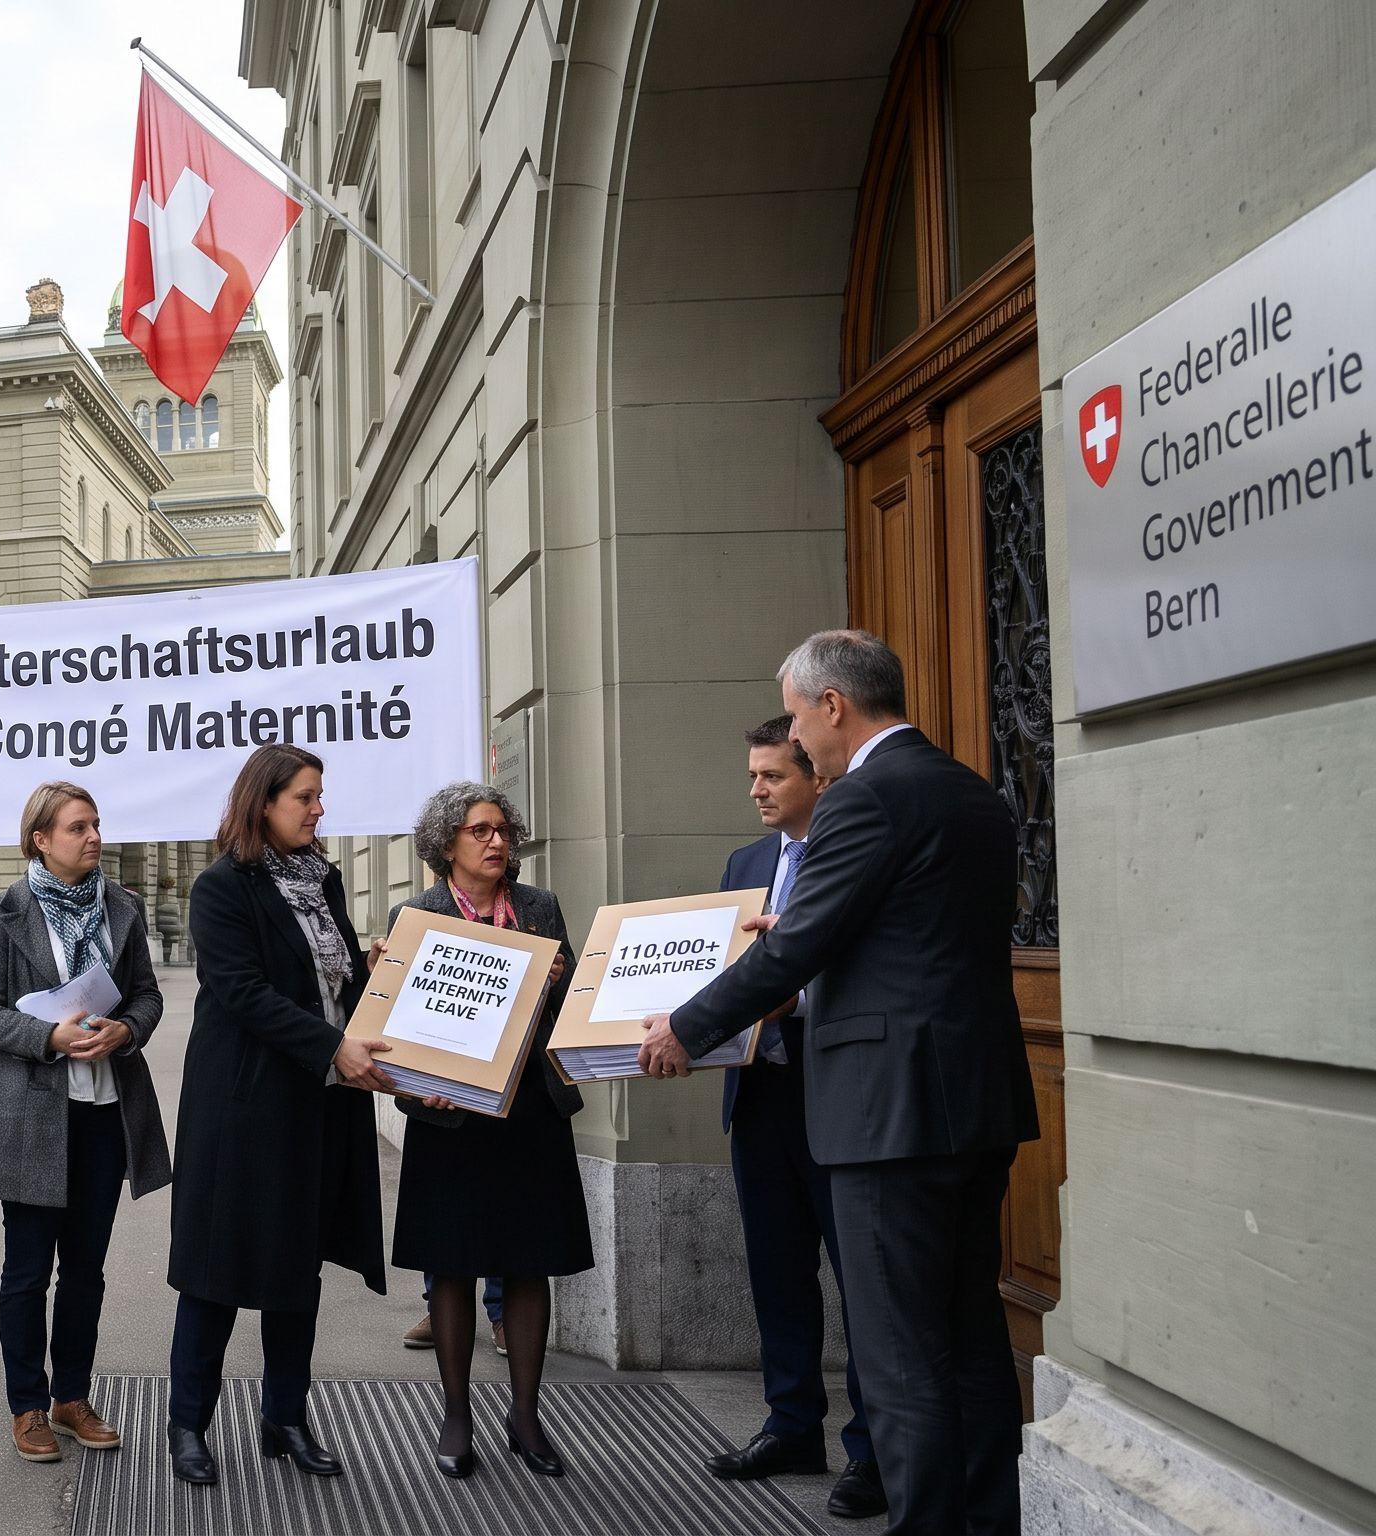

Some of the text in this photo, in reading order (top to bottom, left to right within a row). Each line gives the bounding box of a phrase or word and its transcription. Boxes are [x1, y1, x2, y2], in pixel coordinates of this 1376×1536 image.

[1139, 297, 1292, 417] Federalle
[1140, 347, 1363, 487] Chancellerie
[1142, 427, 1373, 563] Government
[1145, 581, 1220, 640] Bern
[147, 684, 412, 752] Maternité
[431, 943, 512, 973] PETITION:
[620, 938, 721, 961] 110,000+
[423, 960, 509, 990] 6 MONTHS
[610, 958, 717, 979] SIGNATURES
[411, 976, 507, 1008] MATERNITY
[425, 997, 479, 1021] LEAVE
